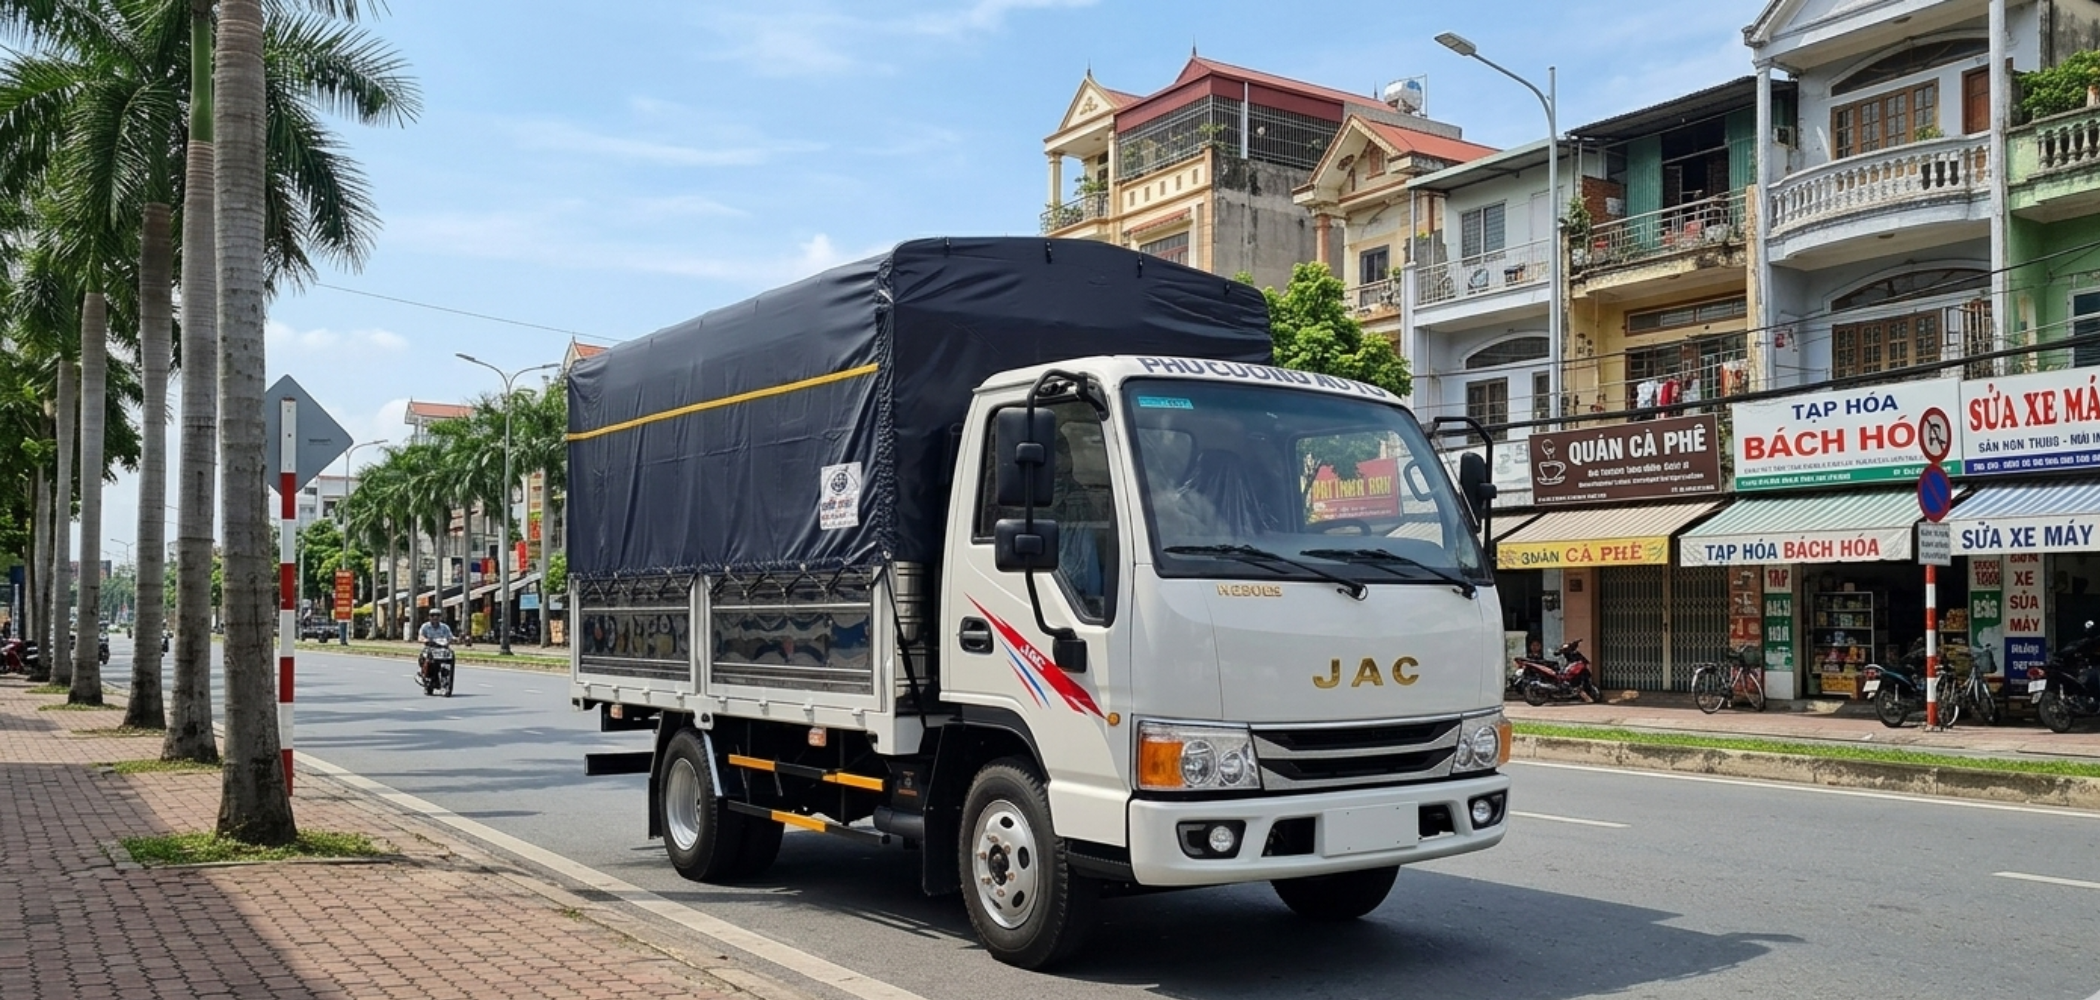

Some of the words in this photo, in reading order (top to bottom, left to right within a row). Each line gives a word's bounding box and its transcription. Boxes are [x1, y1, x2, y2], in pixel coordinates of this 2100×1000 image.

[1791, 400, 1838, 424] TẠP
[1845, 391, 1899, 415] HÓA
[1969, 383, 2019, 432] SỬA
[2023, 390, 2058, 427] XE
[1568, 433, 1624, 466] QUÁN
[1629, 428, 1658, 458] CÀ
[1663, 423, 1707, 455] PHÊ
[1743, 427, 1845, 461] BÁCH
[1858, 415, 1917, 451] HÓ
[1705, 544, 1737, 564] TẠP
[1742, 538, 1778, 560] HÓA
[1783, 536, 1833, 559] BÁCH
[1839, 533, 1880, 557] HÓA
[2009, 527, 2036, 548] XE
[2044, 519, 2094, 547] MÁY
[2014, 571, 2034, 586] XE
[1312, 656, 1420, 689] JAC
